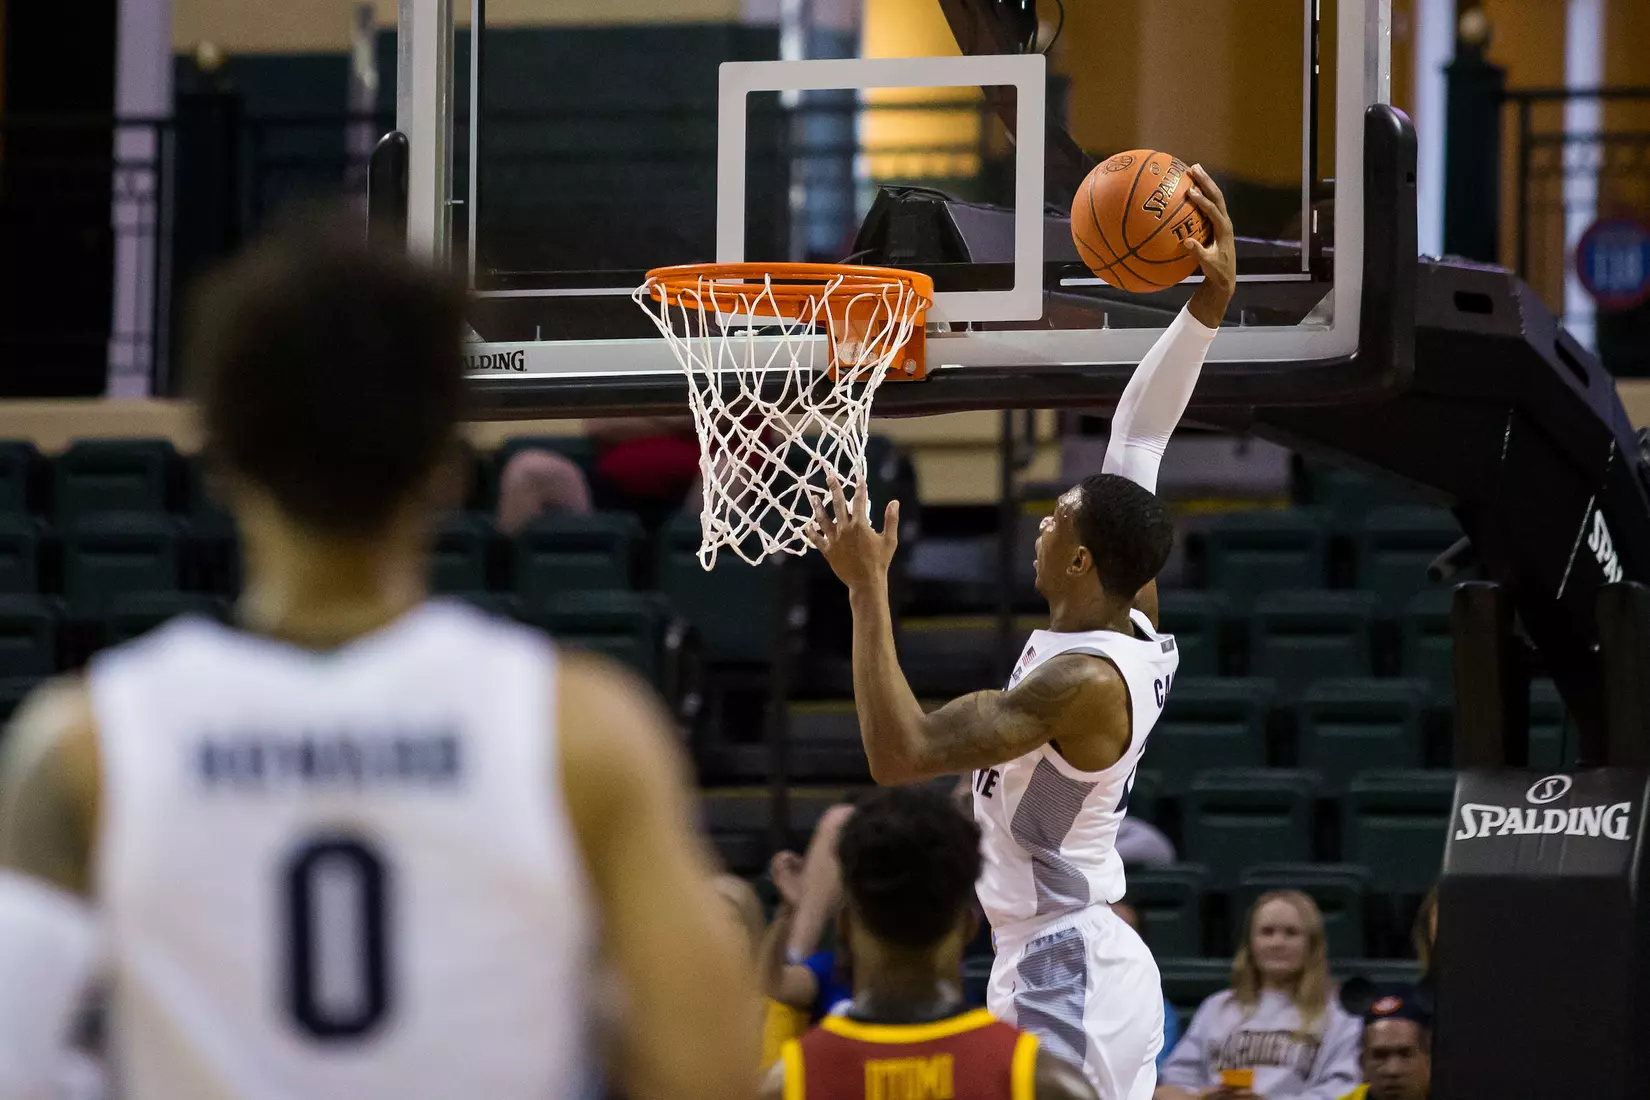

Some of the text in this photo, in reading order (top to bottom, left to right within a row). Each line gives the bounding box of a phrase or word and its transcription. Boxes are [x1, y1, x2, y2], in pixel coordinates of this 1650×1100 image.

[461, 350, 527, 372] ALDING
[1455, 802, 1632, 841] SPALDING
[284, 832, 394, 1044] 0
